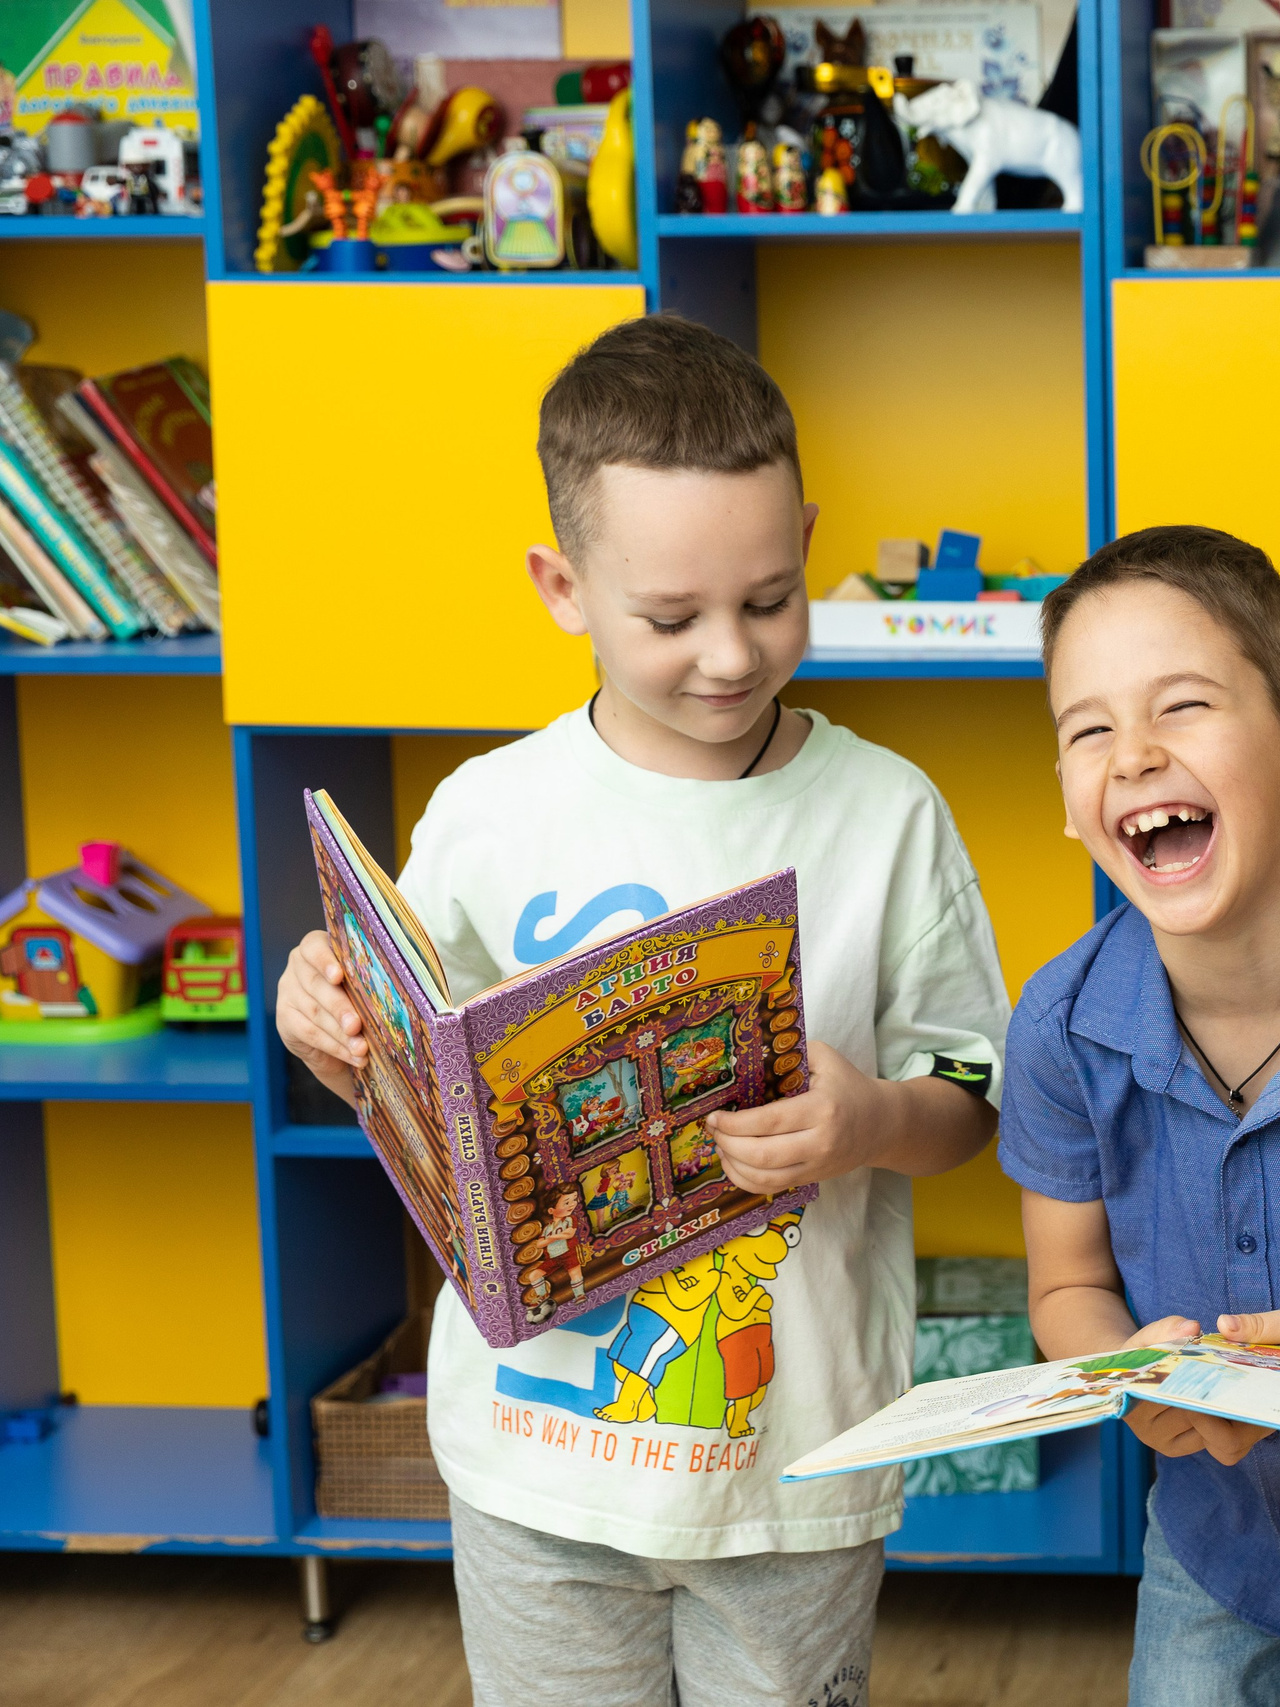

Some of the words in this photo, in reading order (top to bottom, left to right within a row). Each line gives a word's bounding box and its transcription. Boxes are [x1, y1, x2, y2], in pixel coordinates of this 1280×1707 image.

[883, 613, 997, 636] ТОМИК
[574, 943, 697, 1011] АГНИЯ
[581, 967, 697, 1030] БАРТО
[457, 1115, 476, 1161] СТИХИ
[469, 1182, 487, 1223] БАРТО
[476, 1227, 495, 1269] АГНИЯ
[622, 1208, 720, 1266] СТИХИ
[492, 1401, 535, 1438] THIS
[541, 1413, 581, 1453] WAY
[590, 1429, 617, 1461] TO
[631, 1437, 679, 1472] THE
[689, 1439, 760, 1473] BEACH
